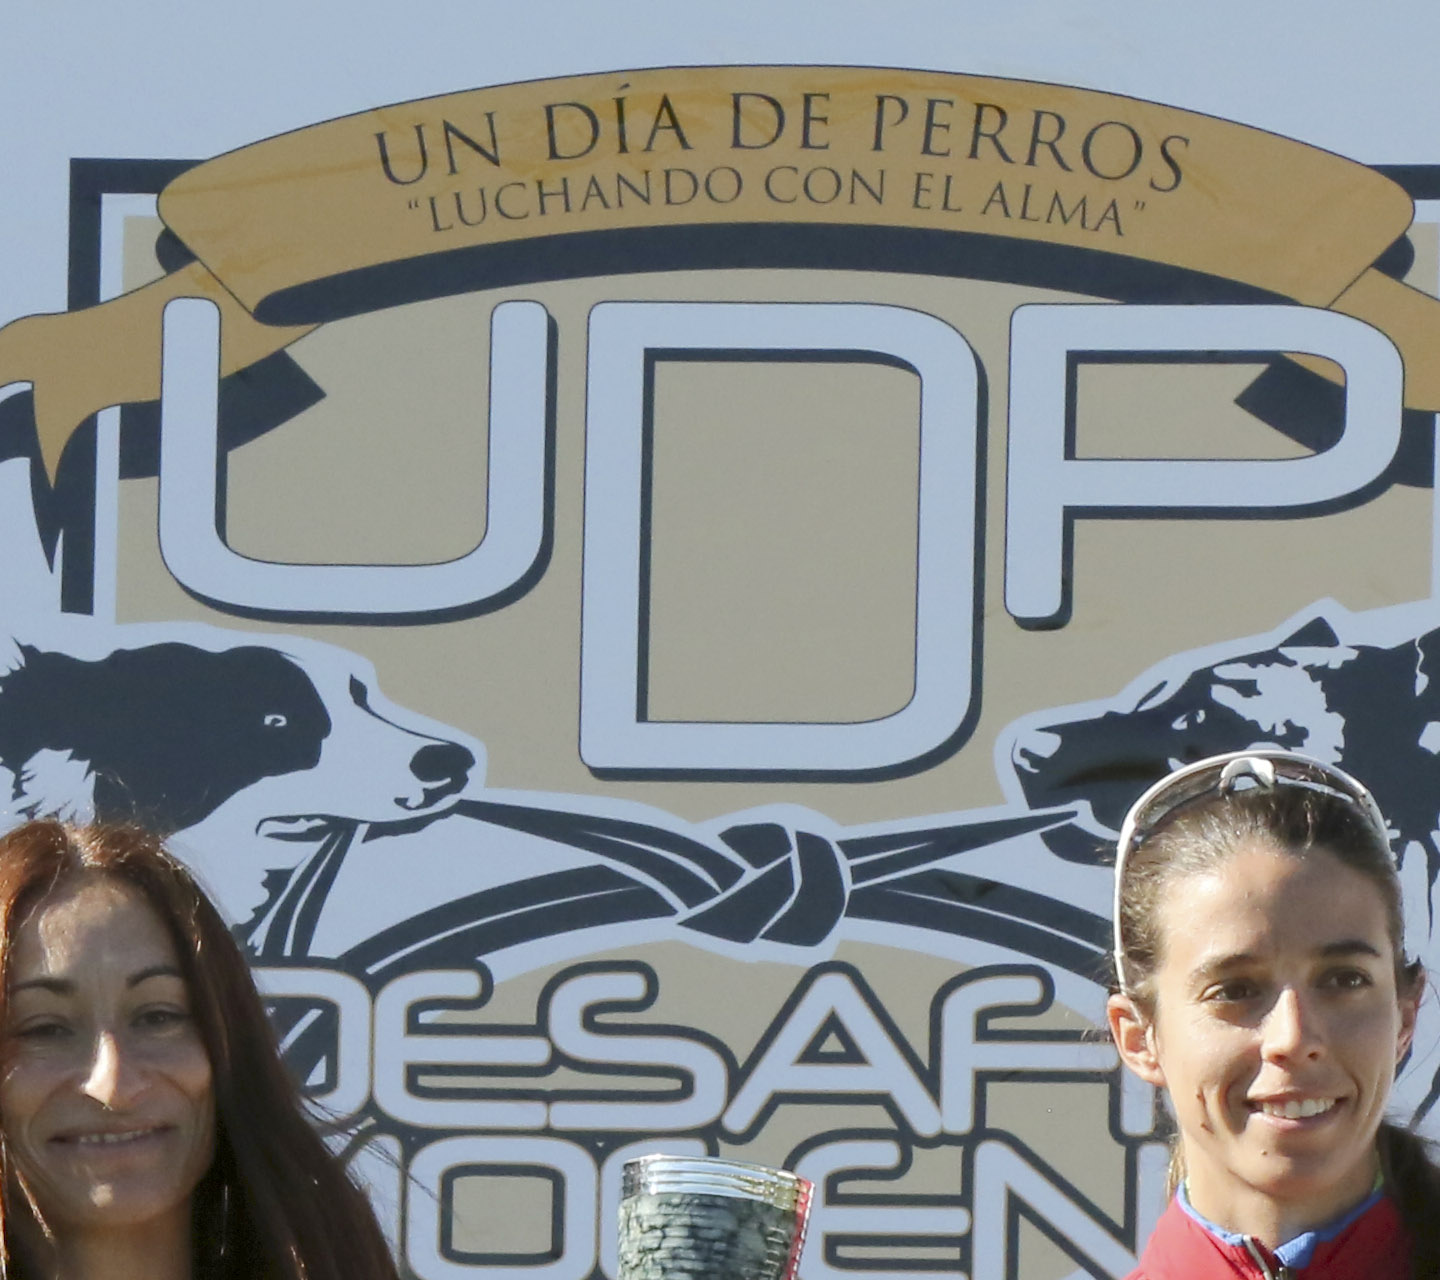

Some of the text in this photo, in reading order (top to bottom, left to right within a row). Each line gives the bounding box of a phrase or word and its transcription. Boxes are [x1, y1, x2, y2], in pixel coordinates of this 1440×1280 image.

[375, 83, 1190, 193] UN DÍA DE PERROS
[764, 165, 885, 205] CON
[913, 172, 962, 213] EL
[158, 296, 1406, 780] UDP
